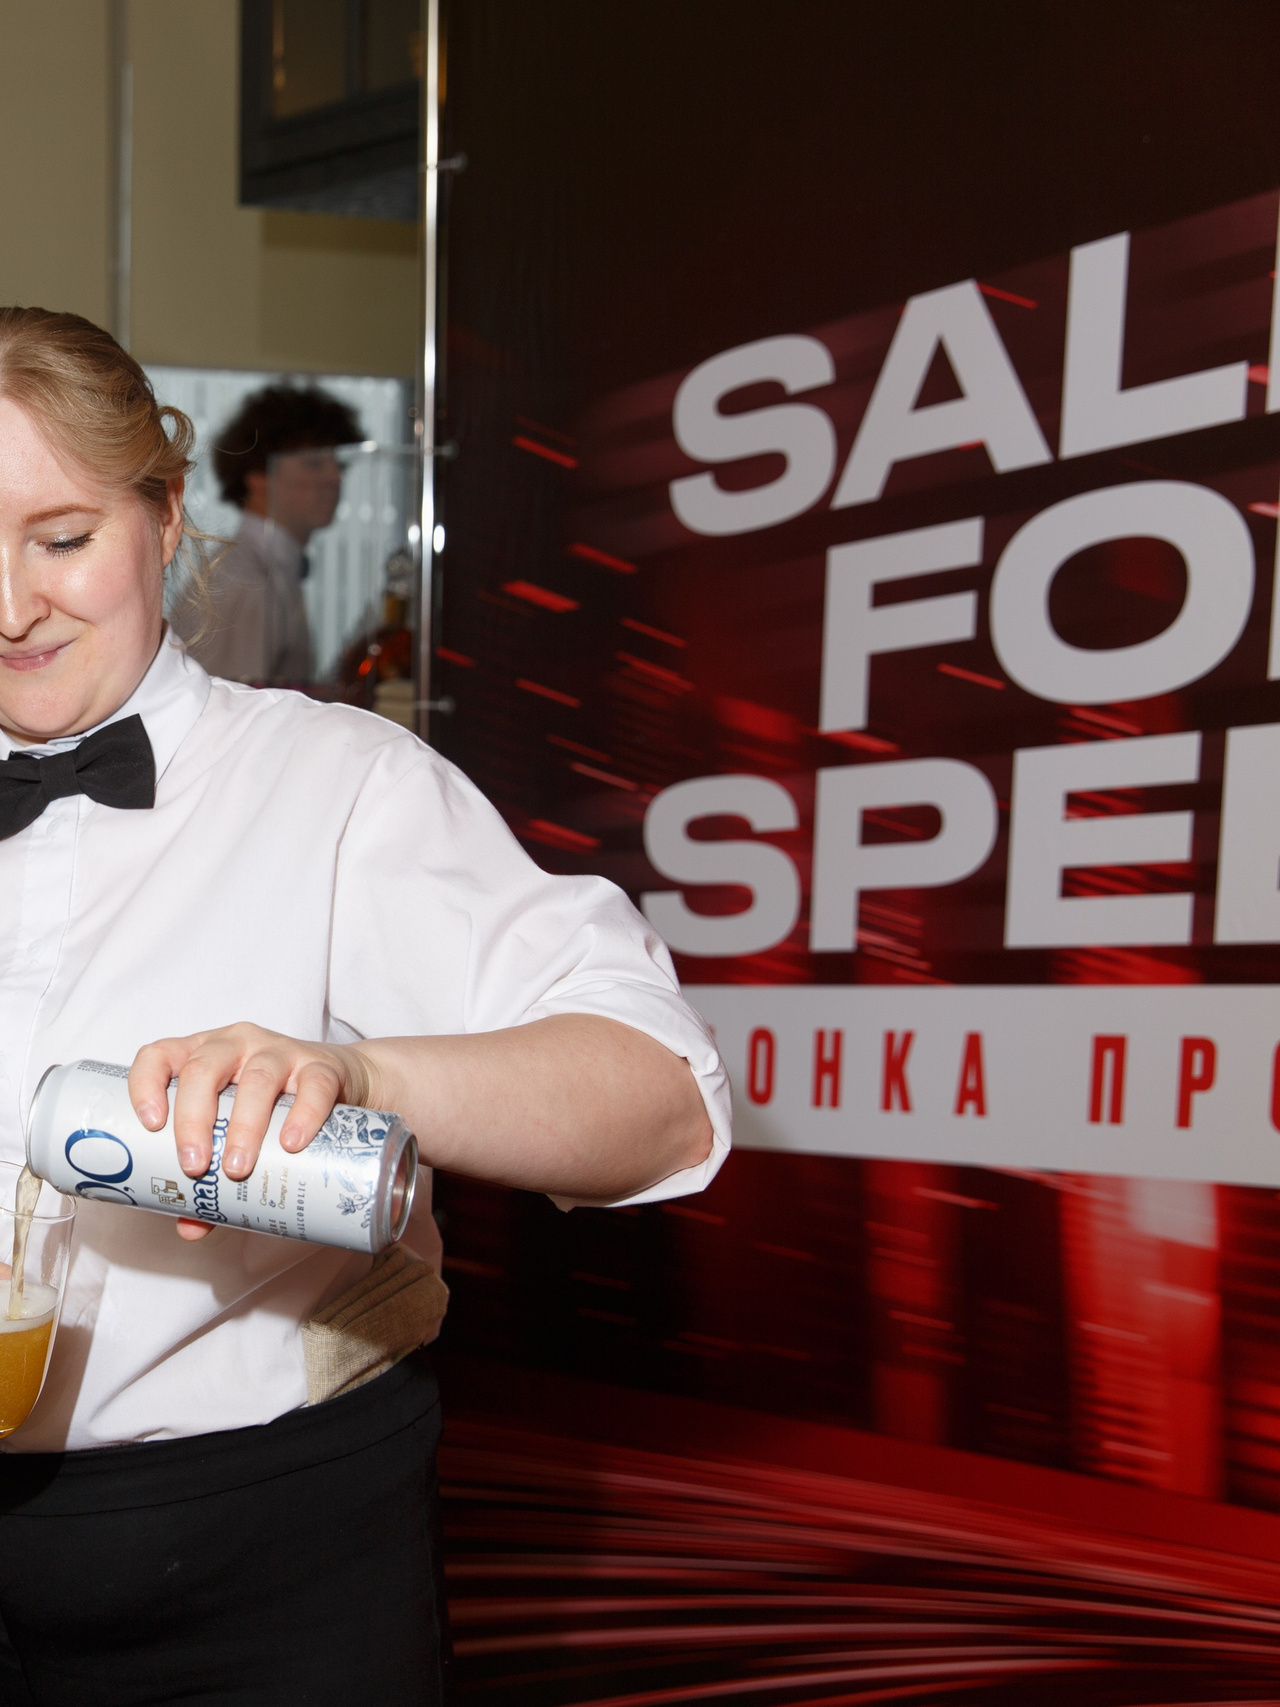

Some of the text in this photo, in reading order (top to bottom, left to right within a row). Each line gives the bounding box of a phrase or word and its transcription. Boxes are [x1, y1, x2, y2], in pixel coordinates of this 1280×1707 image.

[669, 194, 1280, 537] SAL
[819, 480, 1280, 735] FO
[706, 1024, 990, 1118] ОНКА
[260, 1170, 269, 1206] Coriander
[278, 1184, 287, 1210] Orange
